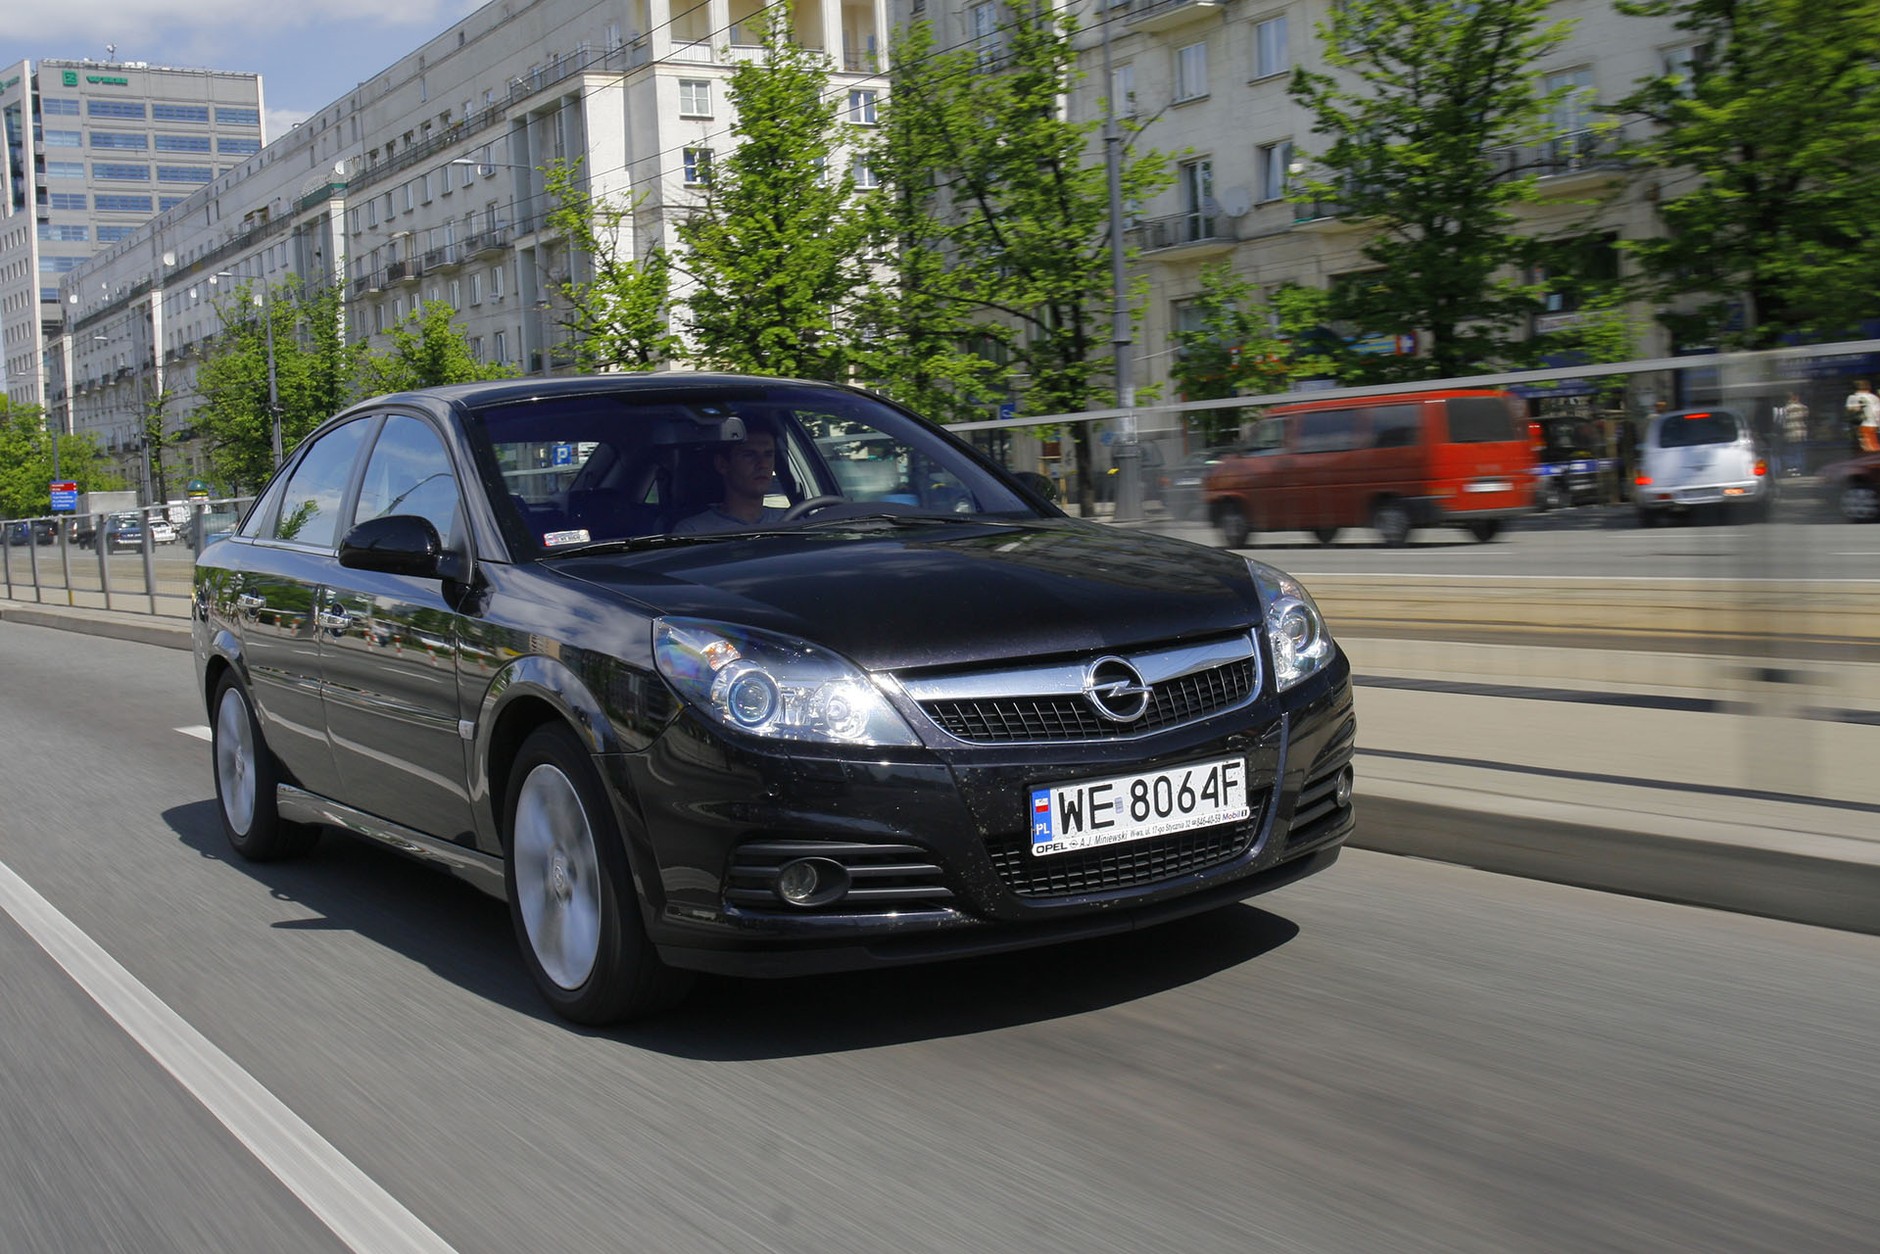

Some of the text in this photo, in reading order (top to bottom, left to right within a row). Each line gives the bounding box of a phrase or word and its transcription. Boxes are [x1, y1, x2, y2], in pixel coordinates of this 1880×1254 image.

[557, 447, 568, 463] P
[1058, 762, 1241, 835] WE 8064F
[1036, 823, 1050, 836] PL
[1036, 842, 1068, 854] OPEL
[1095, 831, 1128, 845] Miniewski
[1222, 811, 1240, 821] Mobil
